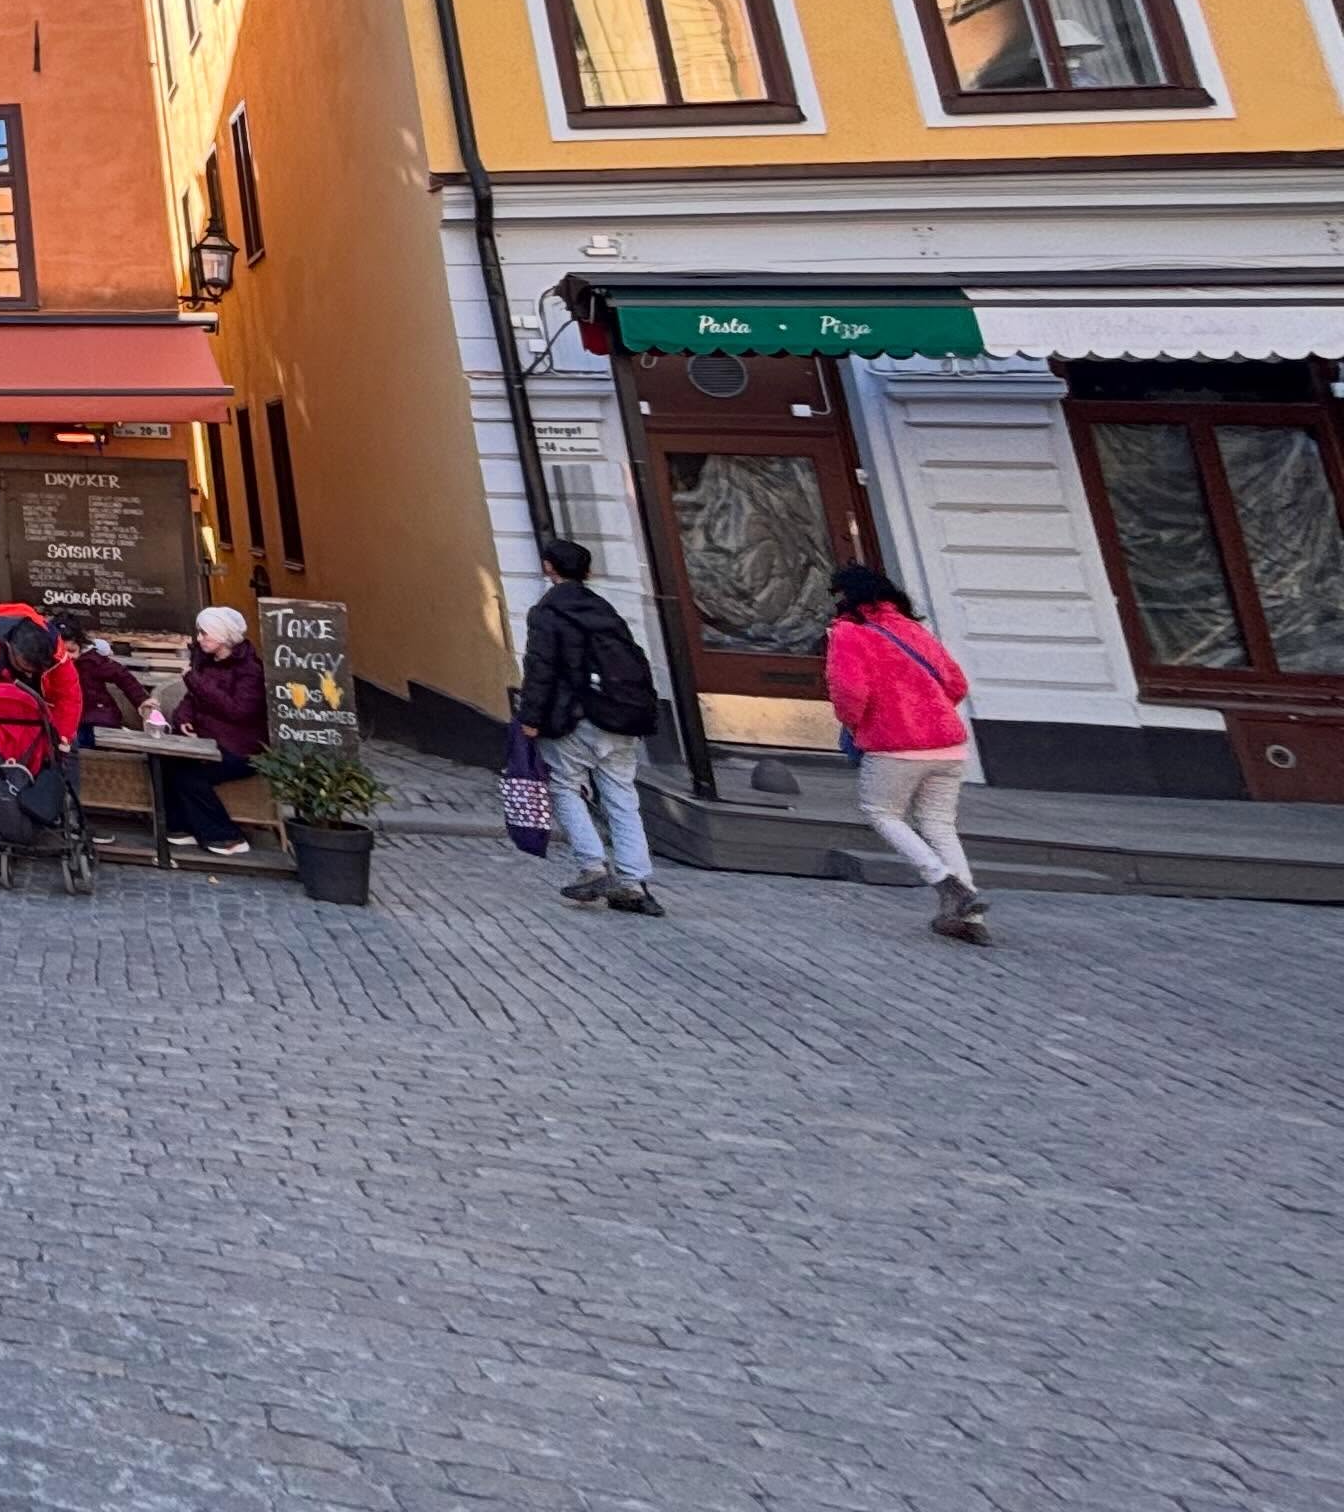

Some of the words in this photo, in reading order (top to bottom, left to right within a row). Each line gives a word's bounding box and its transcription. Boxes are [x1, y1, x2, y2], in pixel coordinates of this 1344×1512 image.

[698, 314, 752, 335] Pasta
[819, 315, 872, 339] Pizza
[44, 472, 121, 489] DRYCKER
[47, 543, 124, 562] SÖTSAKER
[42, 588, 136, 609] SMÖRGÅSAR
[265, 608, 337, 640] TAKE
[274, 644, 345, 673] AWAY
[278, 723, 343, 747] SWEETS
